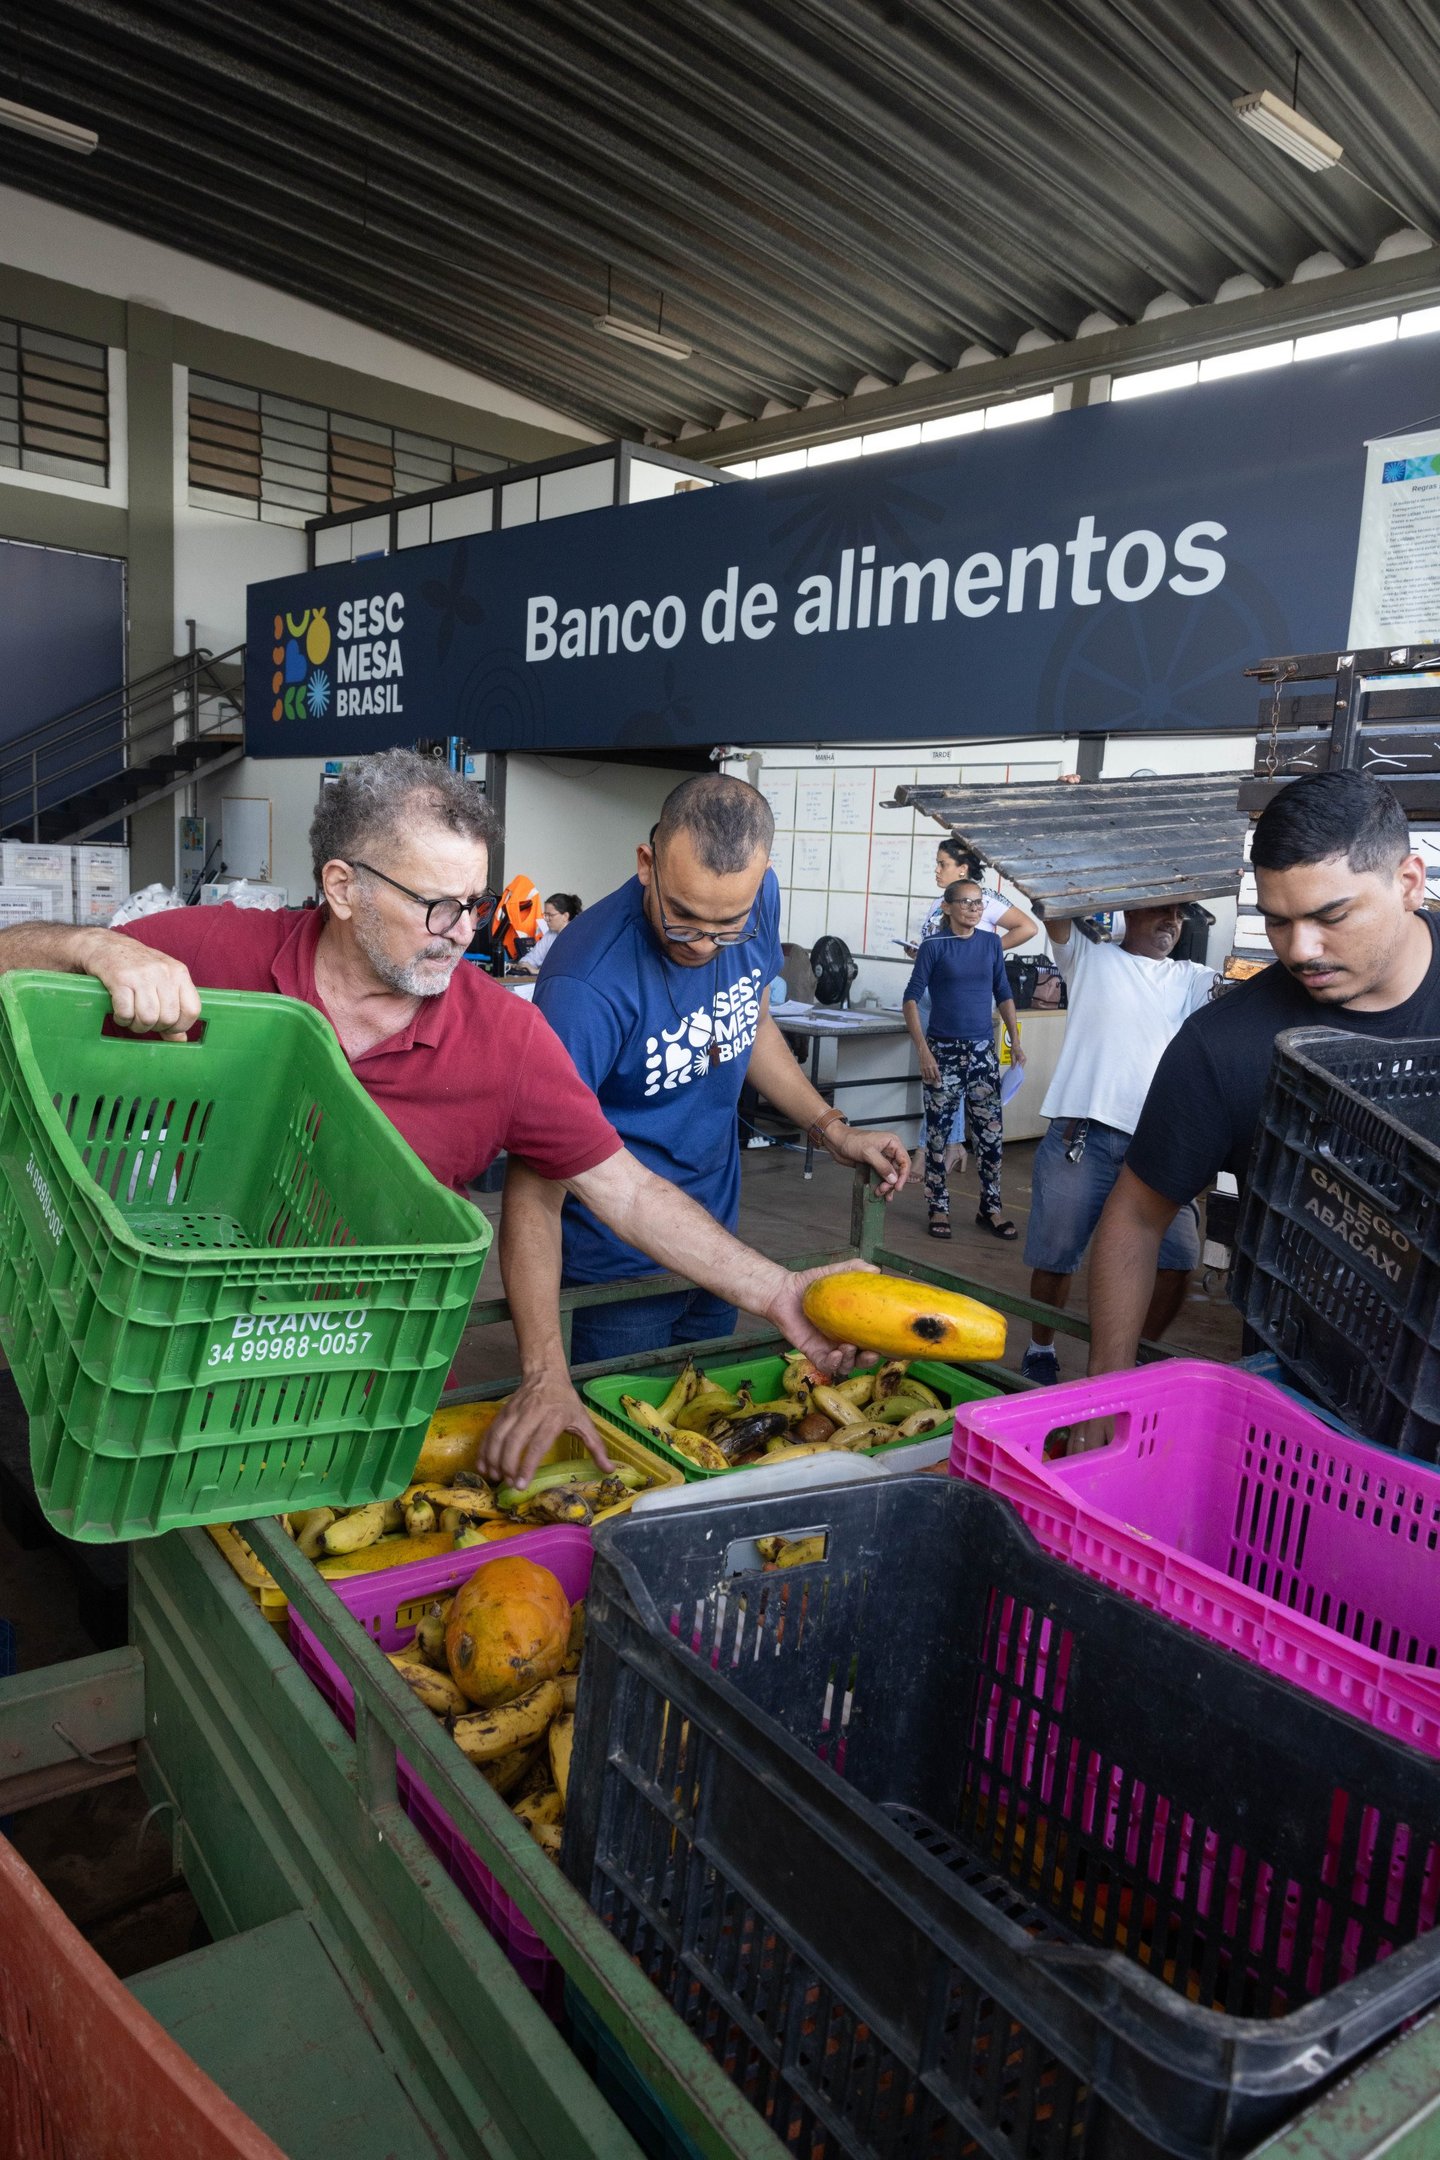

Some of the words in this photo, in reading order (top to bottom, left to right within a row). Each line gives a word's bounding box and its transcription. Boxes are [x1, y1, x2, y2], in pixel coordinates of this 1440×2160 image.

[1412, 484, 1437, 492] Regras
[525, 594, 686, 662] Banco
[701, 566, 778, 645] de
[794, 515, 1228, 636] alimentos
[337, 591, 405, 640] SESC
[337, 639, 404, 683] MESA
[336, 684, 403, 717] BRASIL
[714, 1000, 760, 1042] MES
[717, 1024, 758, 1063] BRAS
[26, 1152, 36, 1180] 34
[32, 1168, 64, 1246] 99988-005
[1311, 1168, 1410, 1252] GALEGO
[1304, 1198, 1402, 1282] ABACAXI
[1343, 1210, 1369, 1235] DO
[231, 1309, 368, 1339] BRANCO
[207, 1342, 235, 1366] 34
[241, 1331, 374, 1362] 99988-0057
